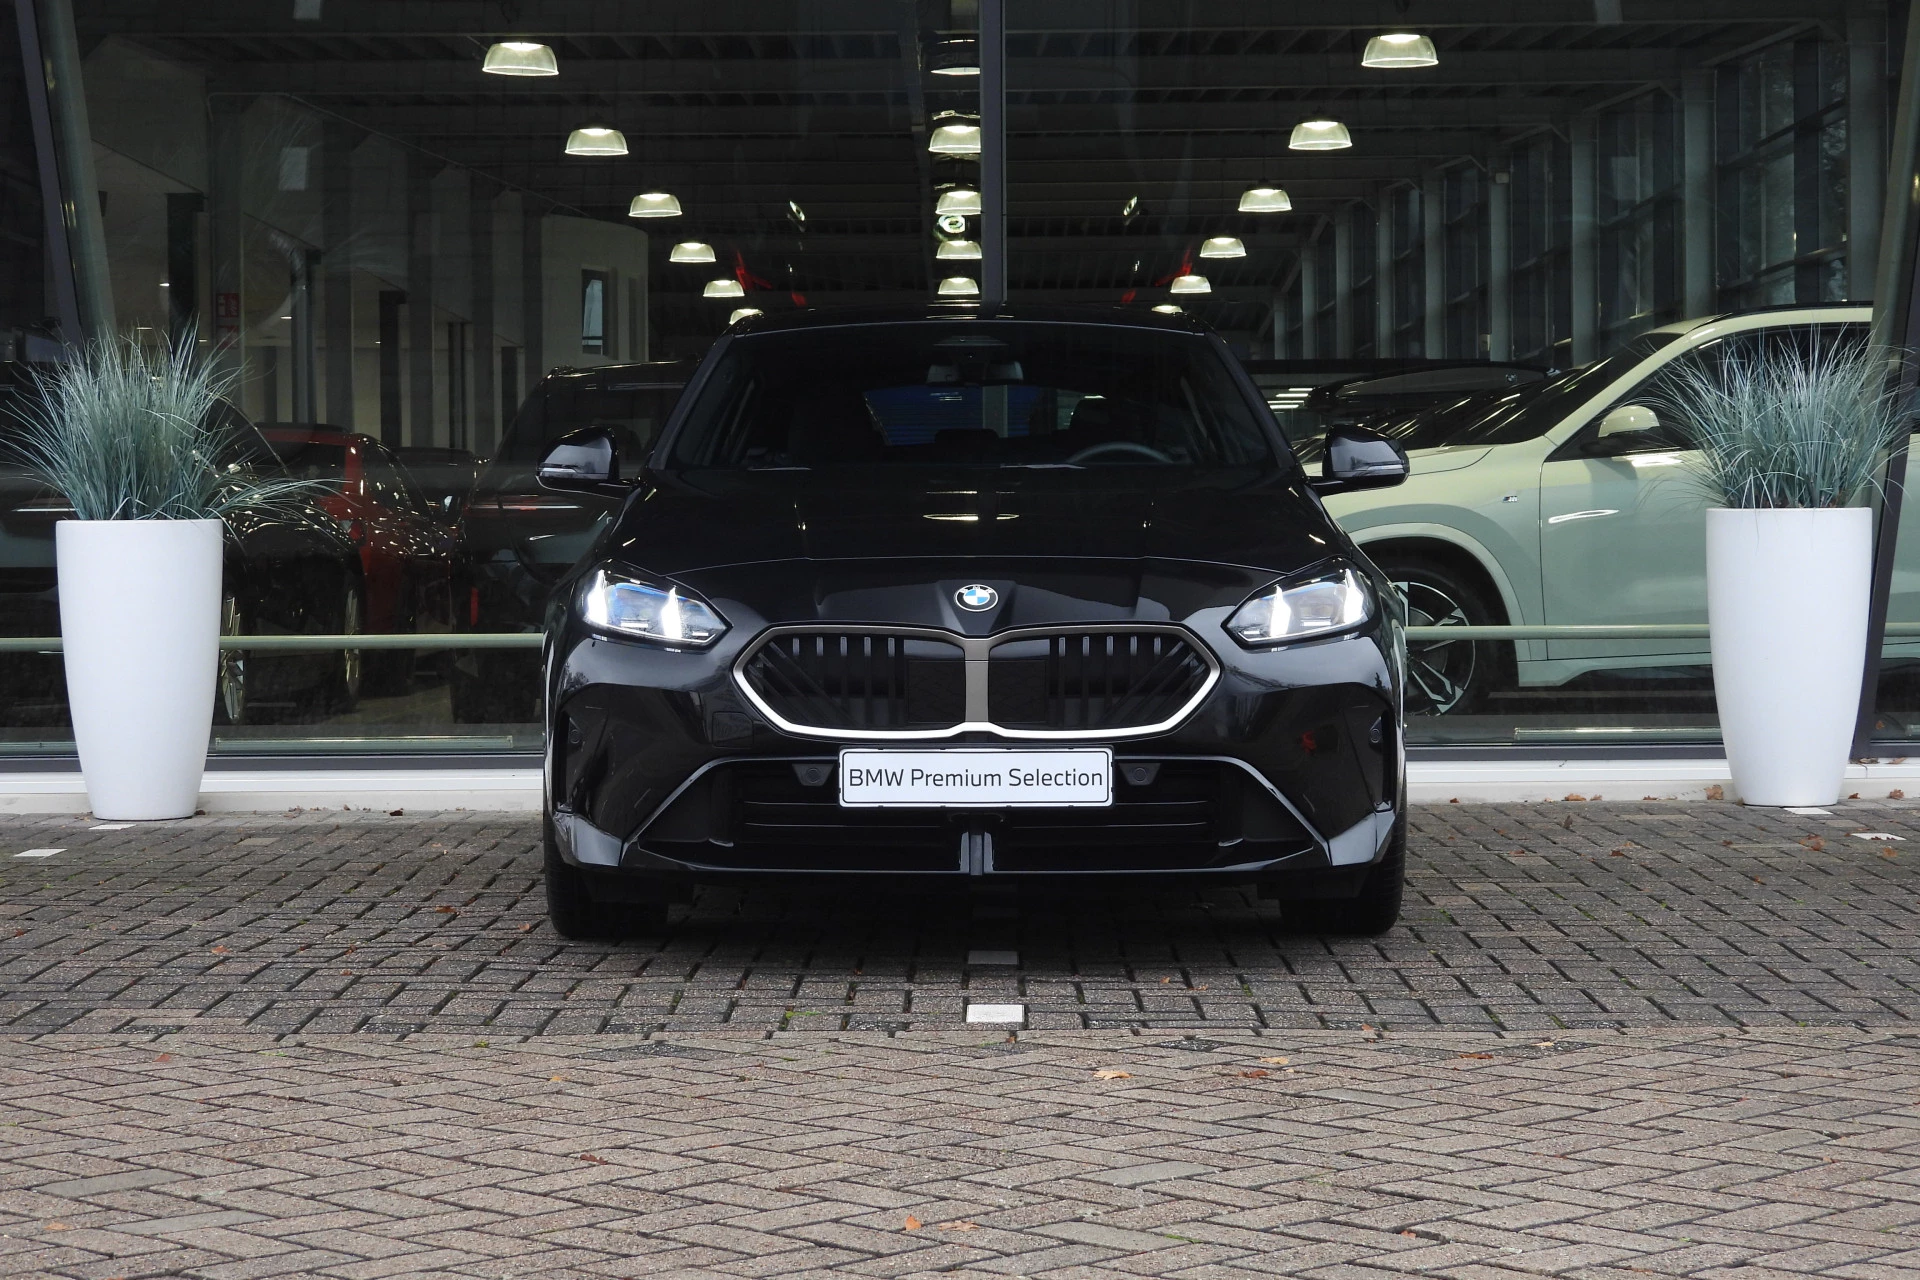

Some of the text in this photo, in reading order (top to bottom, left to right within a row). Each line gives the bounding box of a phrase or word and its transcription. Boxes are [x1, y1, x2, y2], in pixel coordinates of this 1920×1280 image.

[849, 768, 1103, 787] BMW Premium Selection
